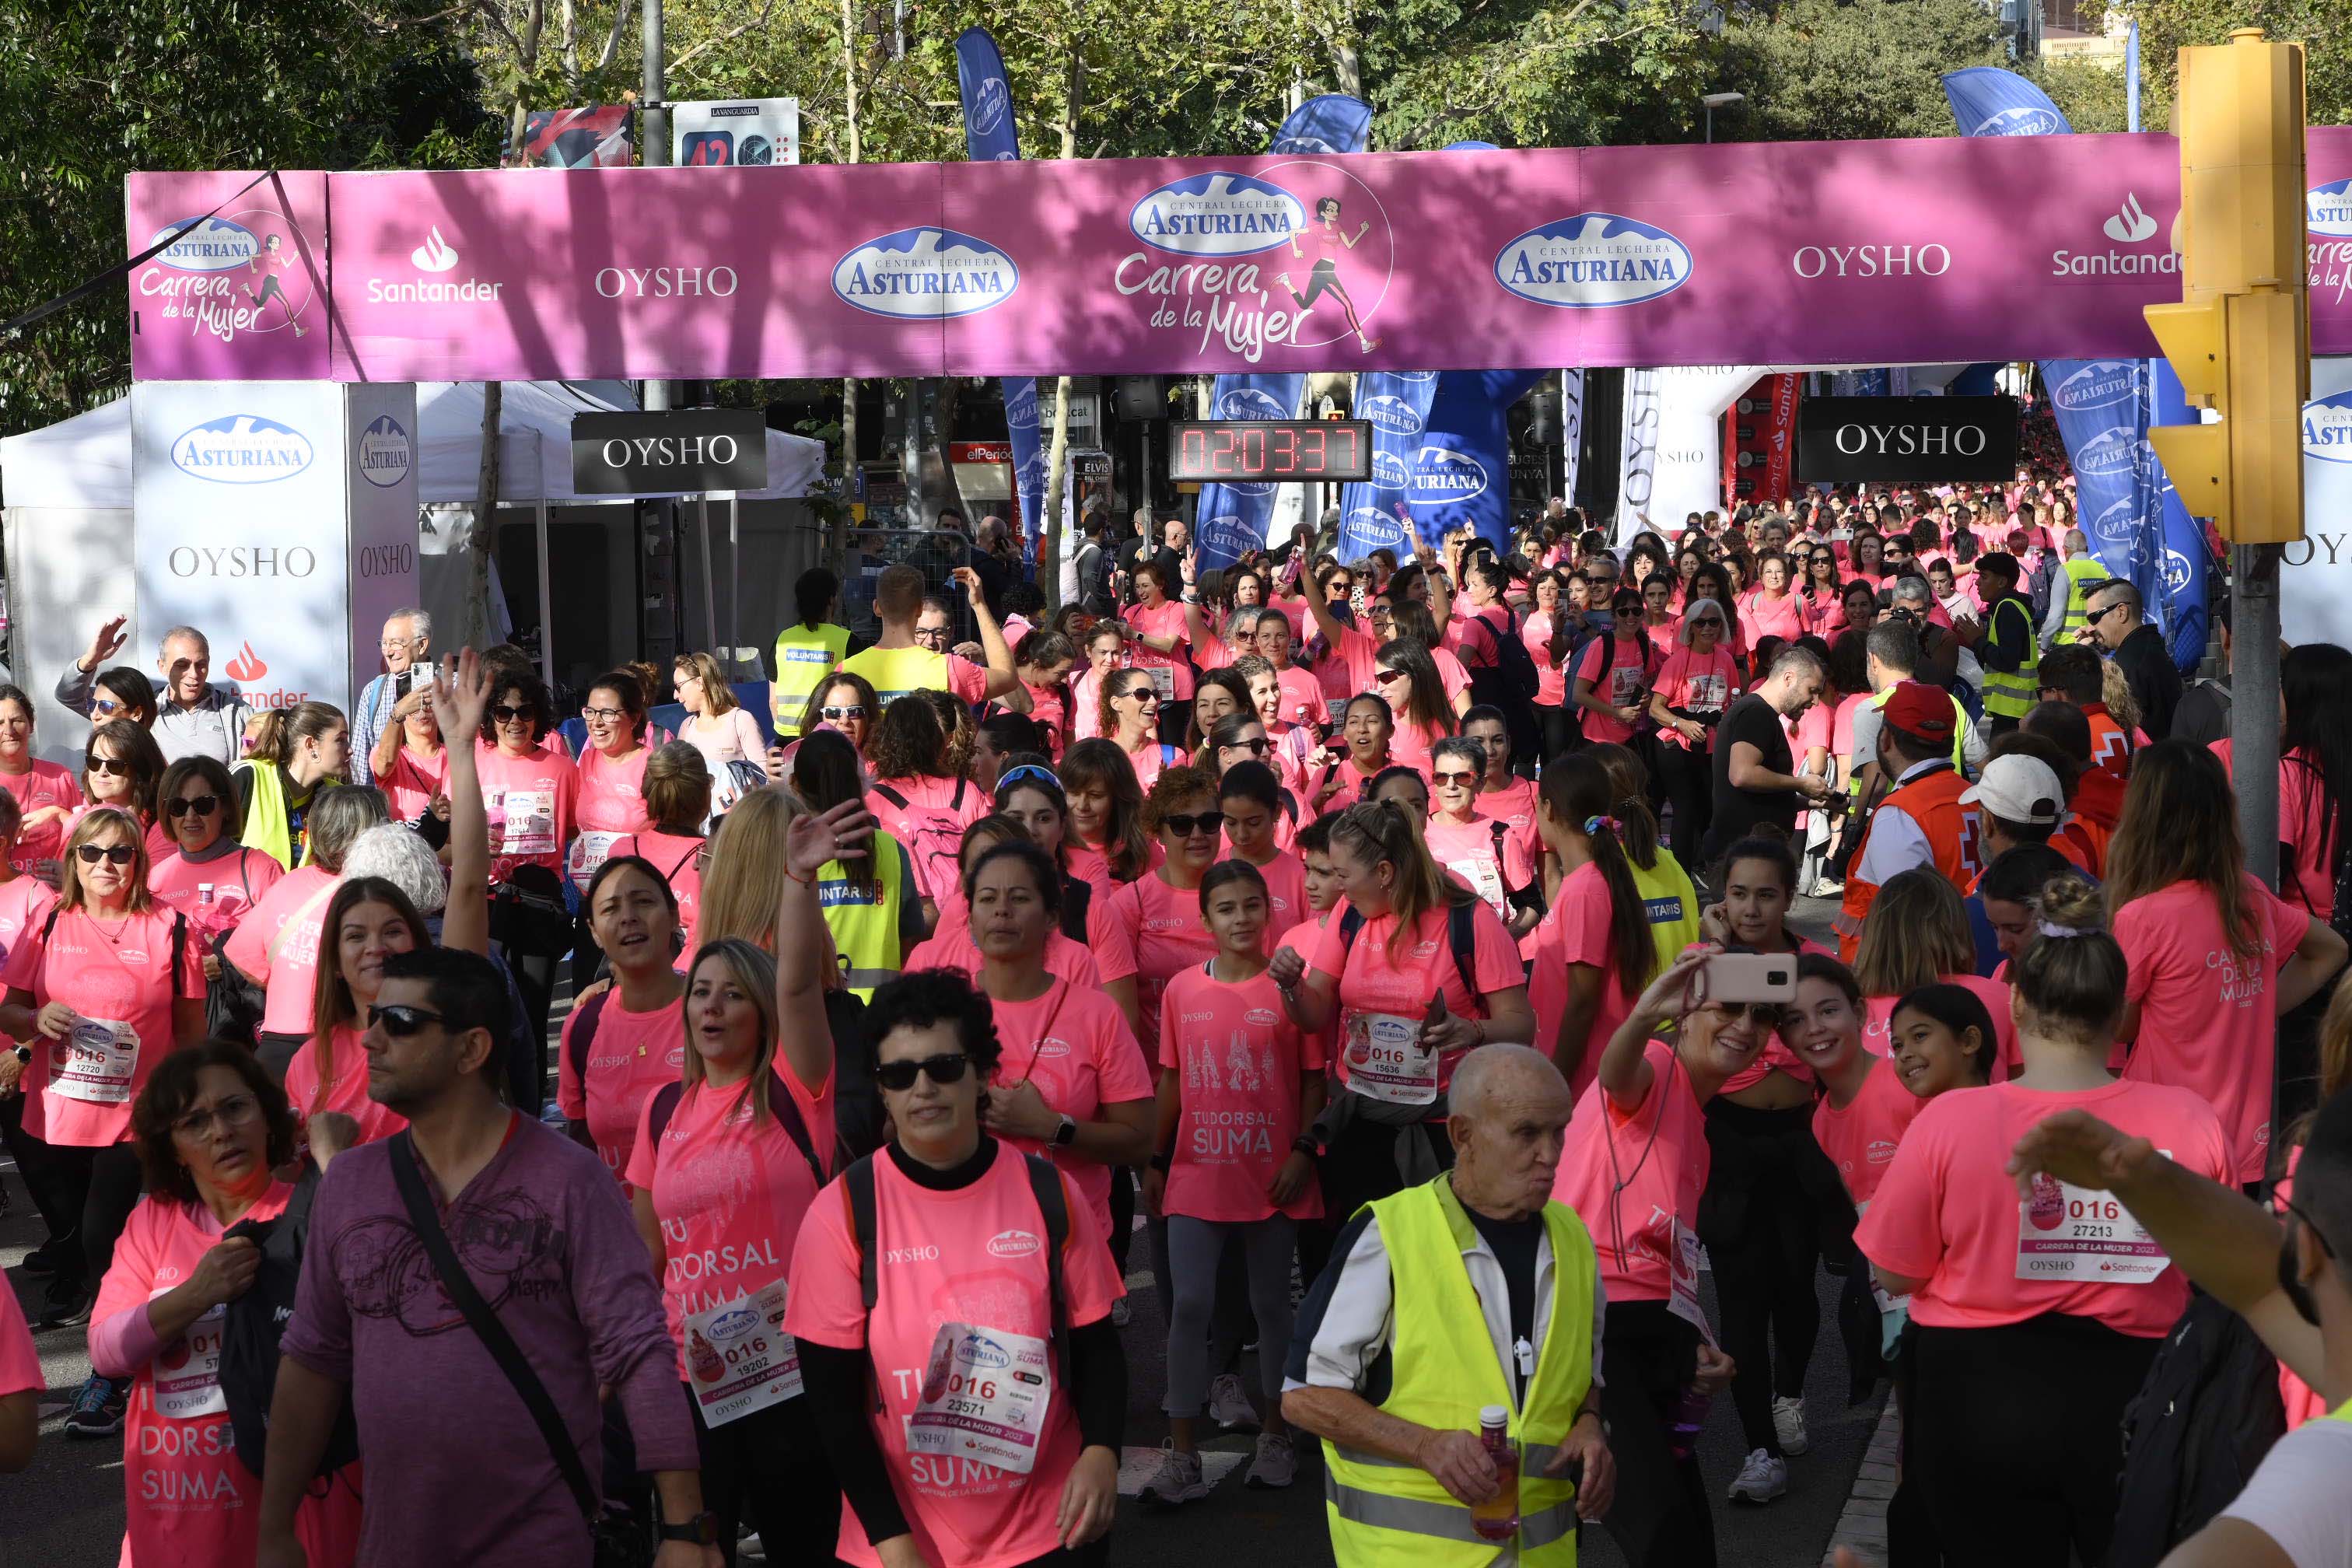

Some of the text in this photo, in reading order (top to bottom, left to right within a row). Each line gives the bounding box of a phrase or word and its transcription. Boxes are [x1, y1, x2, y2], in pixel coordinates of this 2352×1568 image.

[719, 107, 758, 116] VANGUARDIA
[1170, 200, 1289, 211] CENTRAL LECHERA
[1143, 204, 1293, 236] ASTURIANA
[1539, 243, 1671, 256] CENTRAL LECHERA
[875, 257, 998, 268] CENTRAL LECHERA
[1509, 250, 1678, 285] ASTURIANA
[1793, 243, 1951, 278] OYSHO
[139, 268, 231, 296] Carrera
[595, 266, 738, 298] OYSHO
[846, 261, 1004, 296] ASTURIANA
[1115, 252, 1260, 296] Carrera
[2325, 265, 2339, 286] la
[367, 278, 504, 303] Santander
[162, 293, 265, 342] de la Mujer
[1150, 289, 1315, 363] de la Mujer
[1182, 429, 1356, 472] 02:03:37
[1836, 424, 1986, 456] OYSHO
[182, 439, 303, 467] ASTURIANA
[362, 442, 408, 470] ASTURIANA
[603, 435, 737, 467] OYSHO
[1084, 463, 1108, 473] ELVIS
[169, 546, 317, 577] OYSHO
[360, 543, 412, 578] OYSHO
[786, 649, 829, 662] VOLUNTARIS
[506, 816, 530, 826] 016
[586, 855, 606, 864] 016
[2219, 976, 2265, 1003] MUJER
[75, 1048, 106, 1064] 016
[1372, 1048, 1405, 1064] 016
[76, 1063, 101, 1074] 12720
[1375, 1063, 1400, 1074] 15636
[1398, 1088, 1430, 1099] Santander
[1193, 1128, 1273, 1154] SUMA
[2069, 1200, 2119, 1220] 016
[2073, 1224, 2113, 1238] 27213
[992, 1240, 1039, 1253] ASTURIANA
[2090, 1243, 2102, 1251] LA
[2103, 1244, 2133, 1254] MUJER
[2134, 1244, 2156, 1255] 2023
[668, 1238, 779, 1283] DORSAL
[2029, 1260, 2075, 1272] OYSHO
[2111, 1262, 2158, 1274] Santander
[760, 1295, 784, 1311] SUMA
[712, 1313, 758, 1339] ASTURIANA
[725, 1337, 768, 1365] 016
[1016, 1353, 1045, 1367] SUMA
[737, 1356, 770, 1377] 19202
[170, 1377, 206, 1391] CARRERA
[712, 1364, 790, 1399] CARRERA DE LA MUJER
[948, 1373, 997, 1399] 016
[166, 1394, 208, 1411] OYSHO
[715, 1395, 752, 1416] OYSHO
[947, 1398, 985, 1417] 23571
[948, 1416, 958, 1426] DE
[958, 1418, 971, 1428] LA
[972, 1422, 1003, 1436] MUJER
[977, 1442, 1024, 1462] Santander
[141, 1468, 238, 1501] SUMA
